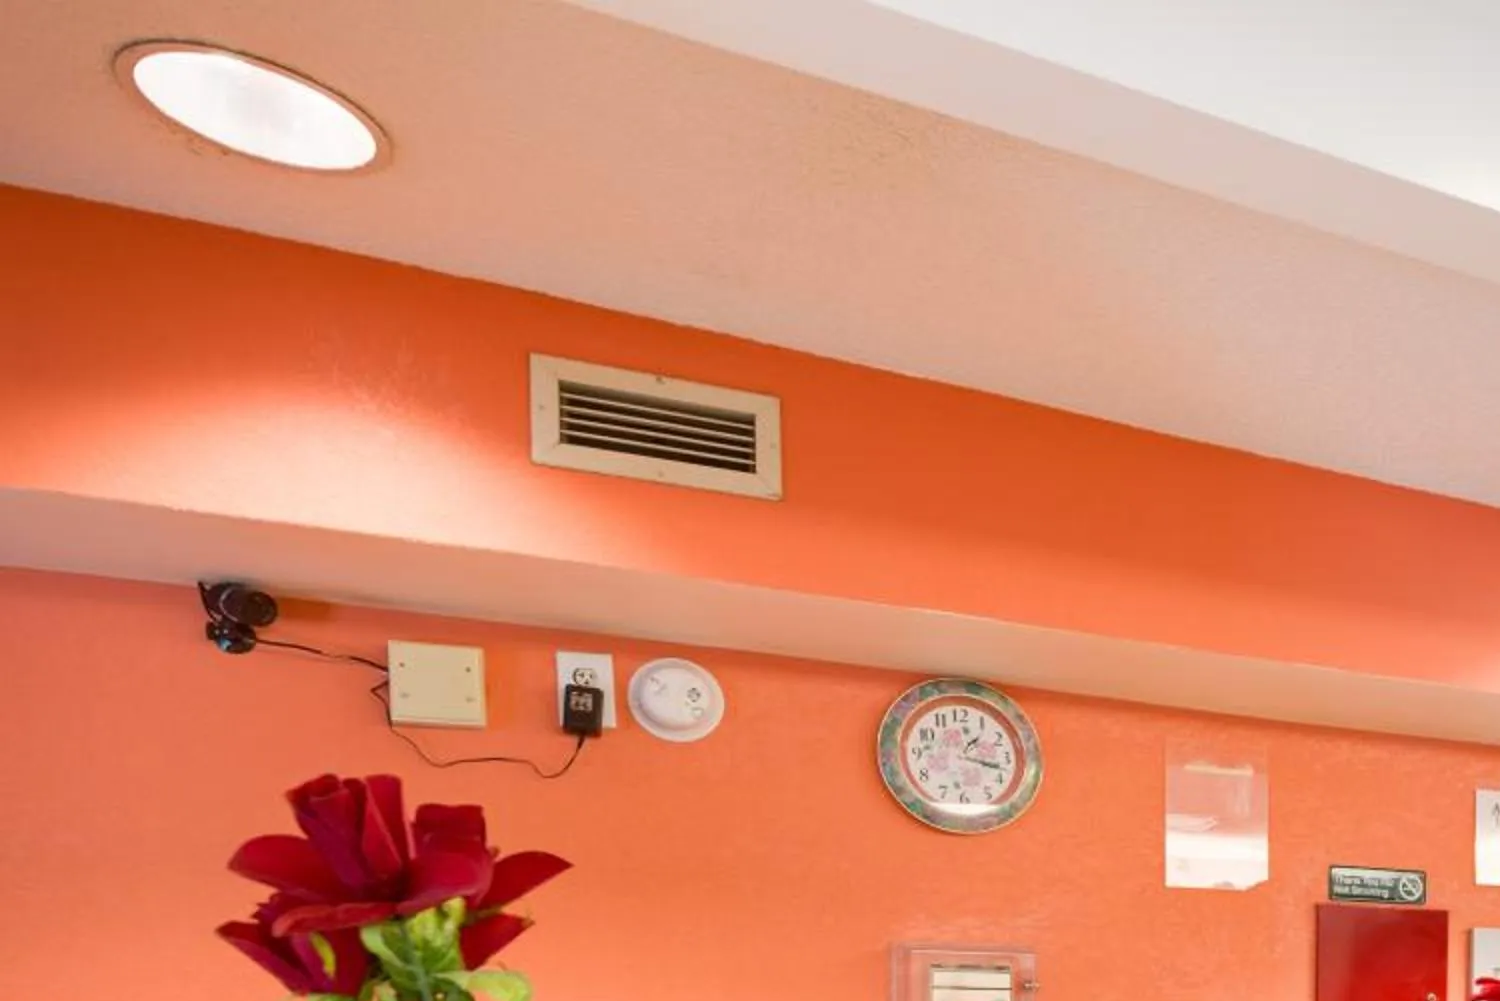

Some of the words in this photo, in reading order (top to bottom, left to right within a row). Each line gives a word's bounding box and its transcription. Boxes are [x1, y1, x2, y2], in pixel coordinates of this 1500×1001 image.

[953, 709, 969, 723] 12
[994, 731, 1003, 747] 2
[920, 768, 929, 781] 8
[938, 785, 948, 799] 7
[984, 786, 993, 800] 5
